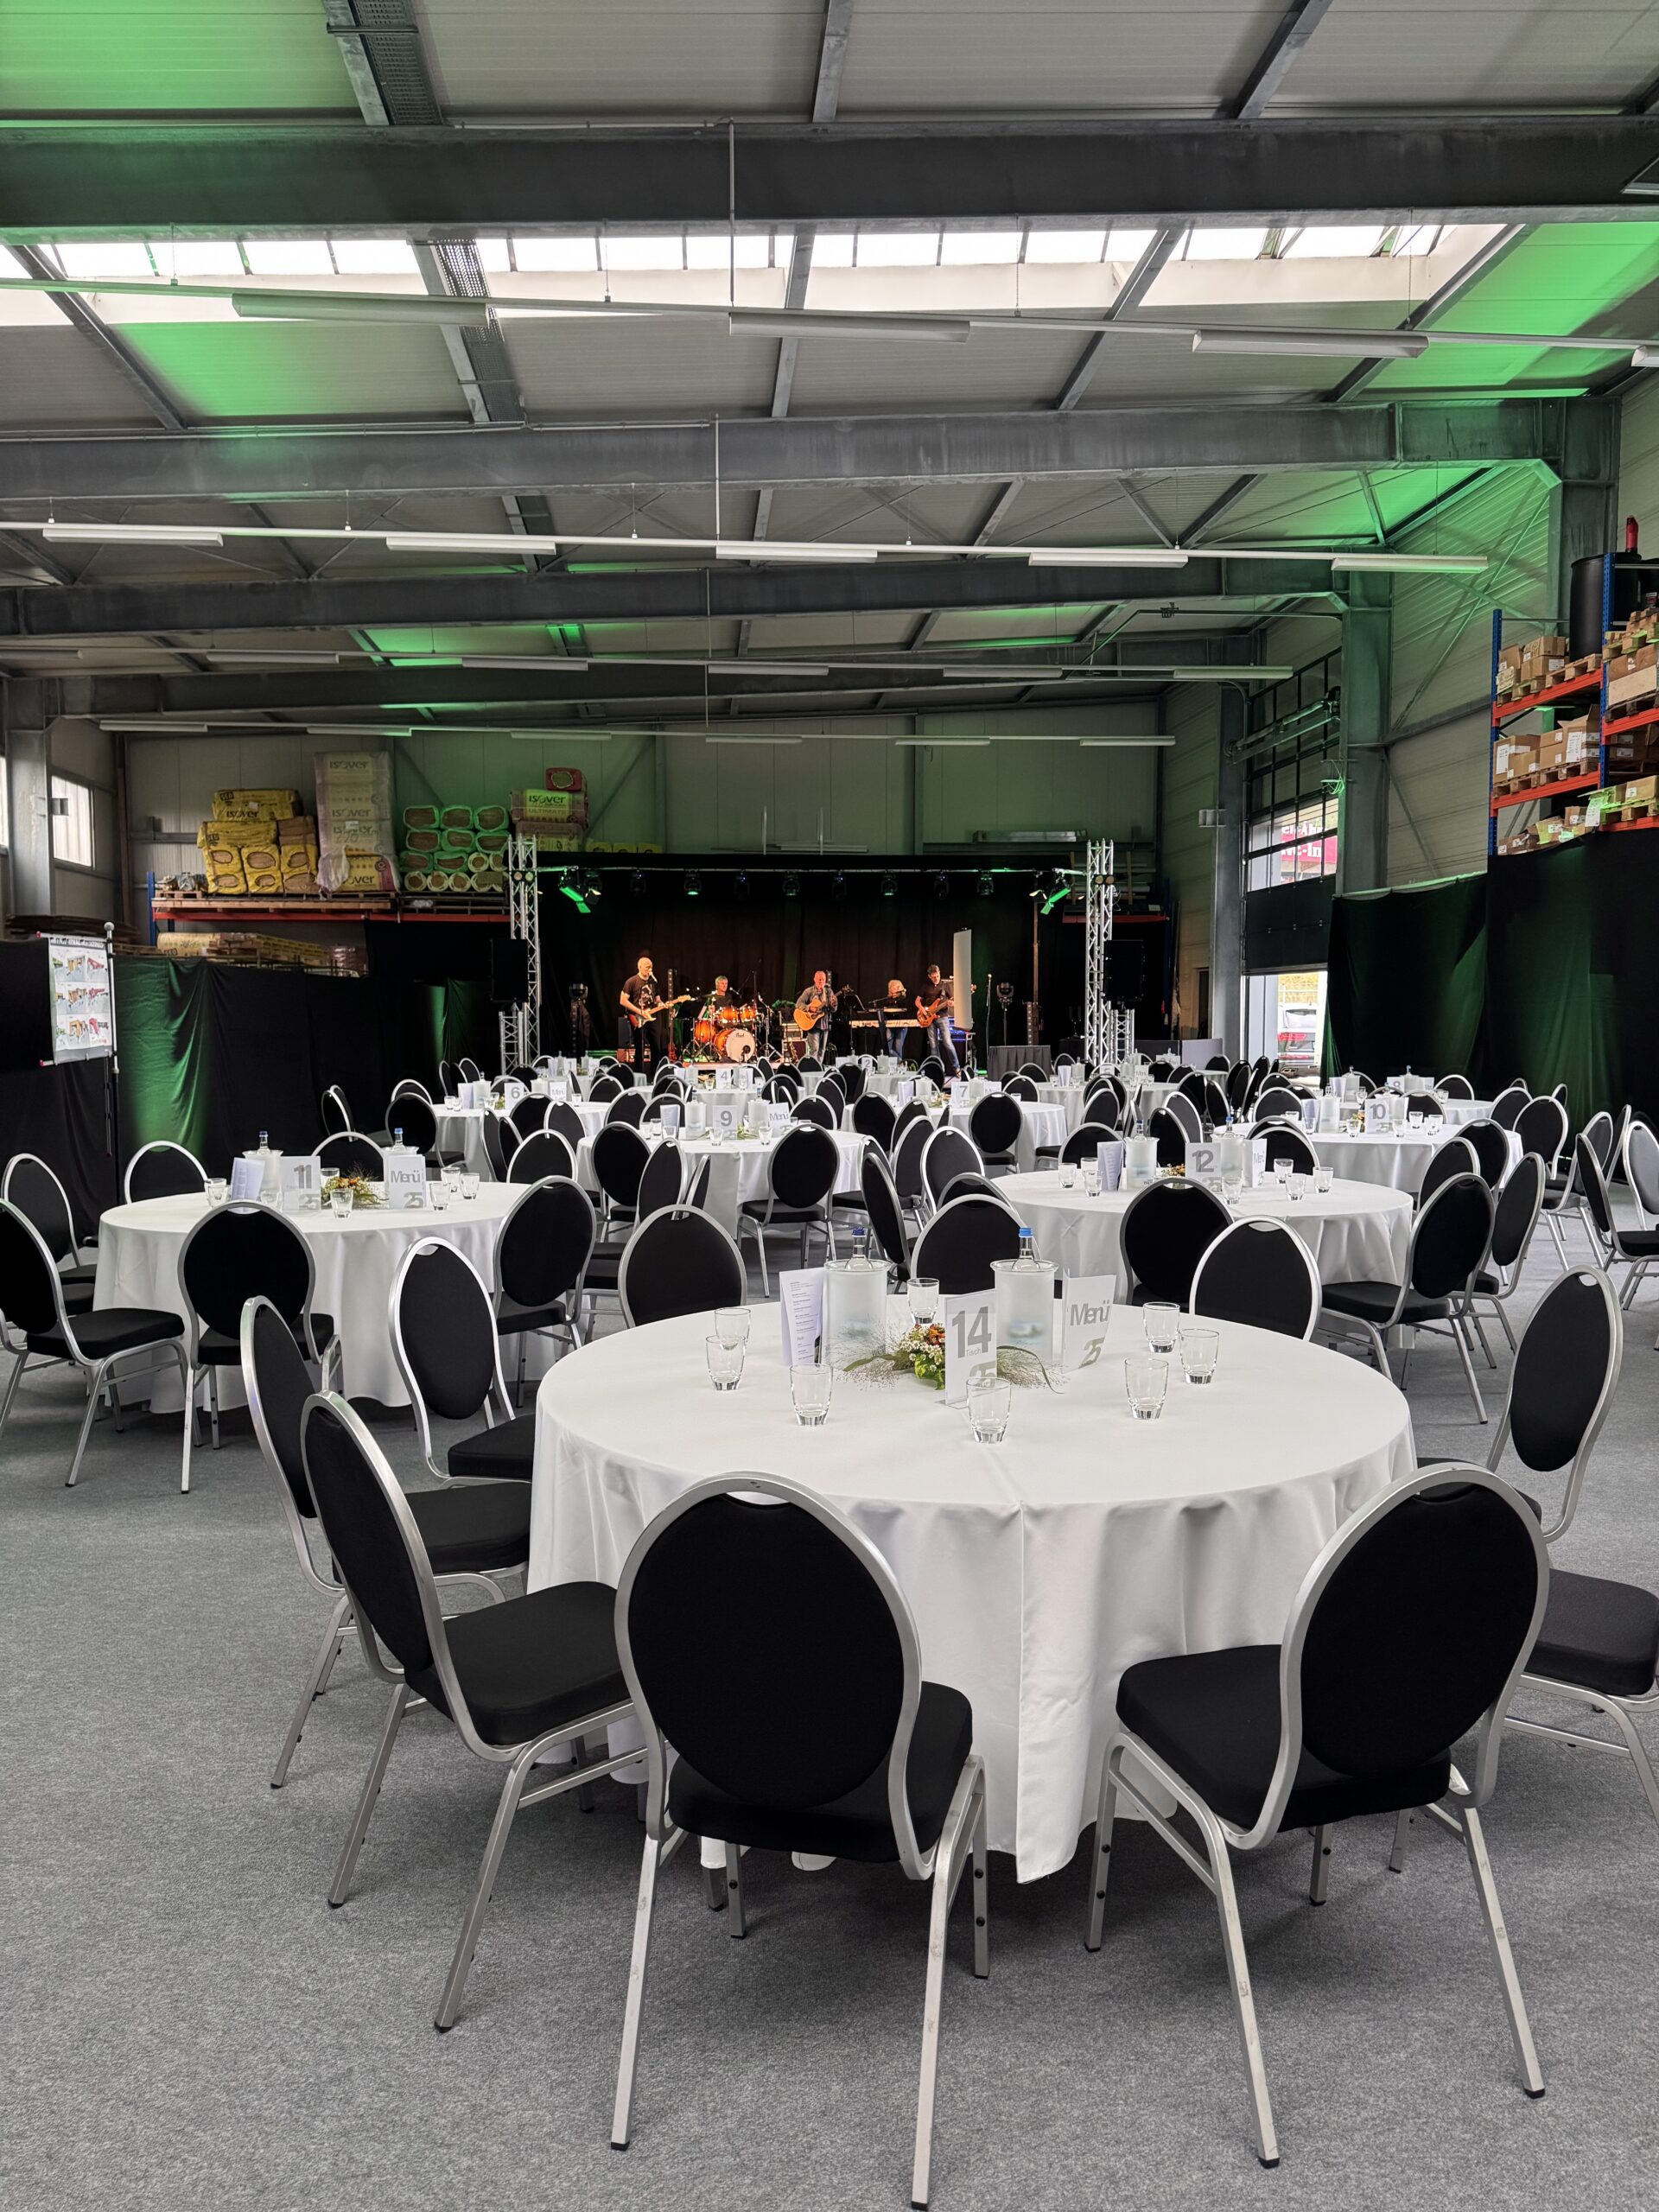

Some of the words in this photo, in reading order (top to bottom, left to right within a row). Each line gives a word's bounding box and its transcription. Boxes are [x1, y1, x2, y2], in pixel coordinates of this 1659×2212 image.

[721, 1071, 728, 1081] 4
[511, 1086, 520, 1099] 6
[959, 1085, 968, 1097] 7
[721, 1110, 733, 1127] 9
[1370, 1103, 1387, 1120] 10
[1192, 1149, 1215, 1173] 12
[294, 1164, 312, 1189] 11
[391, 1170, 421, 1183] Menü
[404, 1192, 424, 1209] 25
[1070, 1300, 1112, 1326] Menü
[951, 1306, 992, 1359] 14
[965, 1348, 982, 1357] Tisch
[1079, 1337, 1106, 1370] 25
